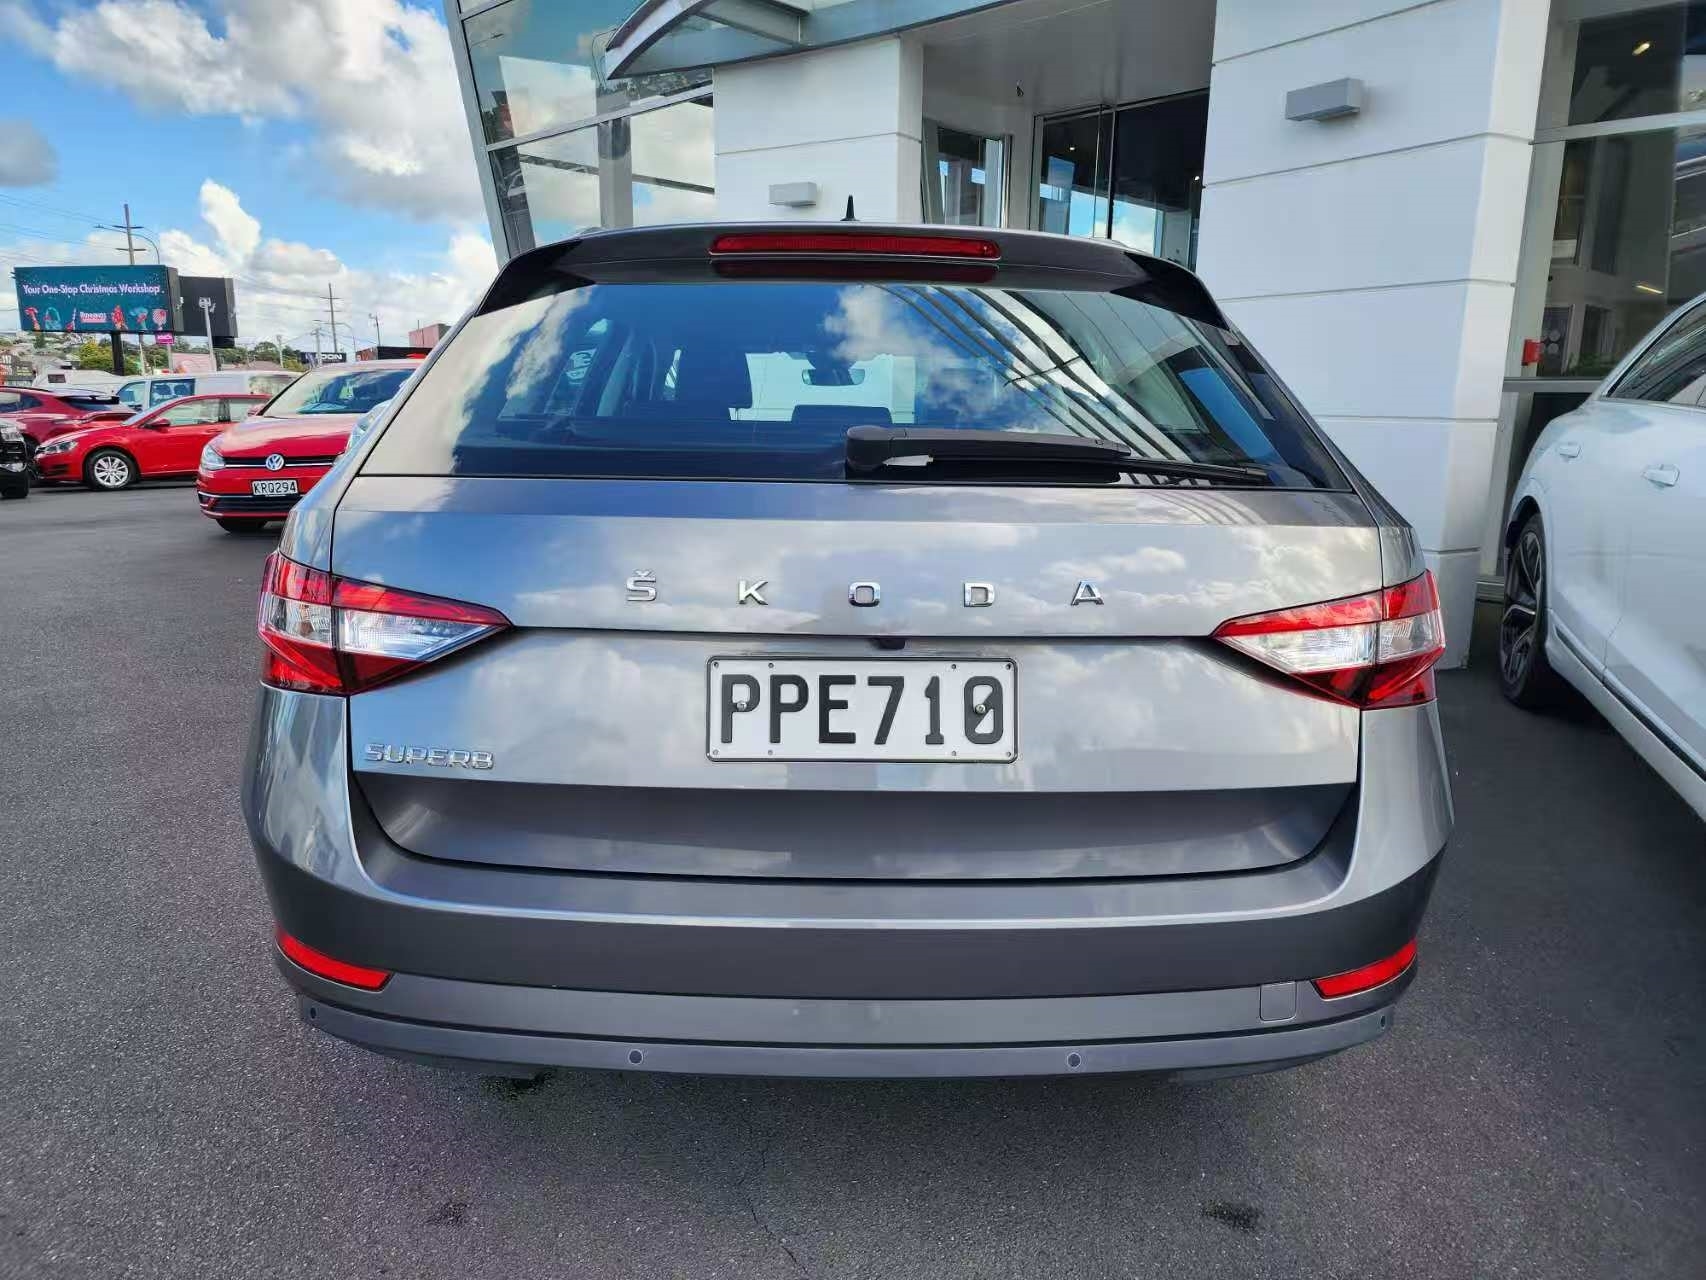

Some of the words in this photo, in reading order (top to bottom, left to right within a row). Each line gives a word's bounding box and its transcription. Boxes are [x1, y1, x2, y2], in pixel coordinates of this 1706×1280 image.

[22, 285, 40, 294] Your
[41, 284, 78, 295] One-Stop
[79, 284, 118, 294] Christmas
[626, 569, 1104, 607] ŠKODA
[721, 674, 1004, 745] PPE710
[365, 743, 494, 769] SUPERB
